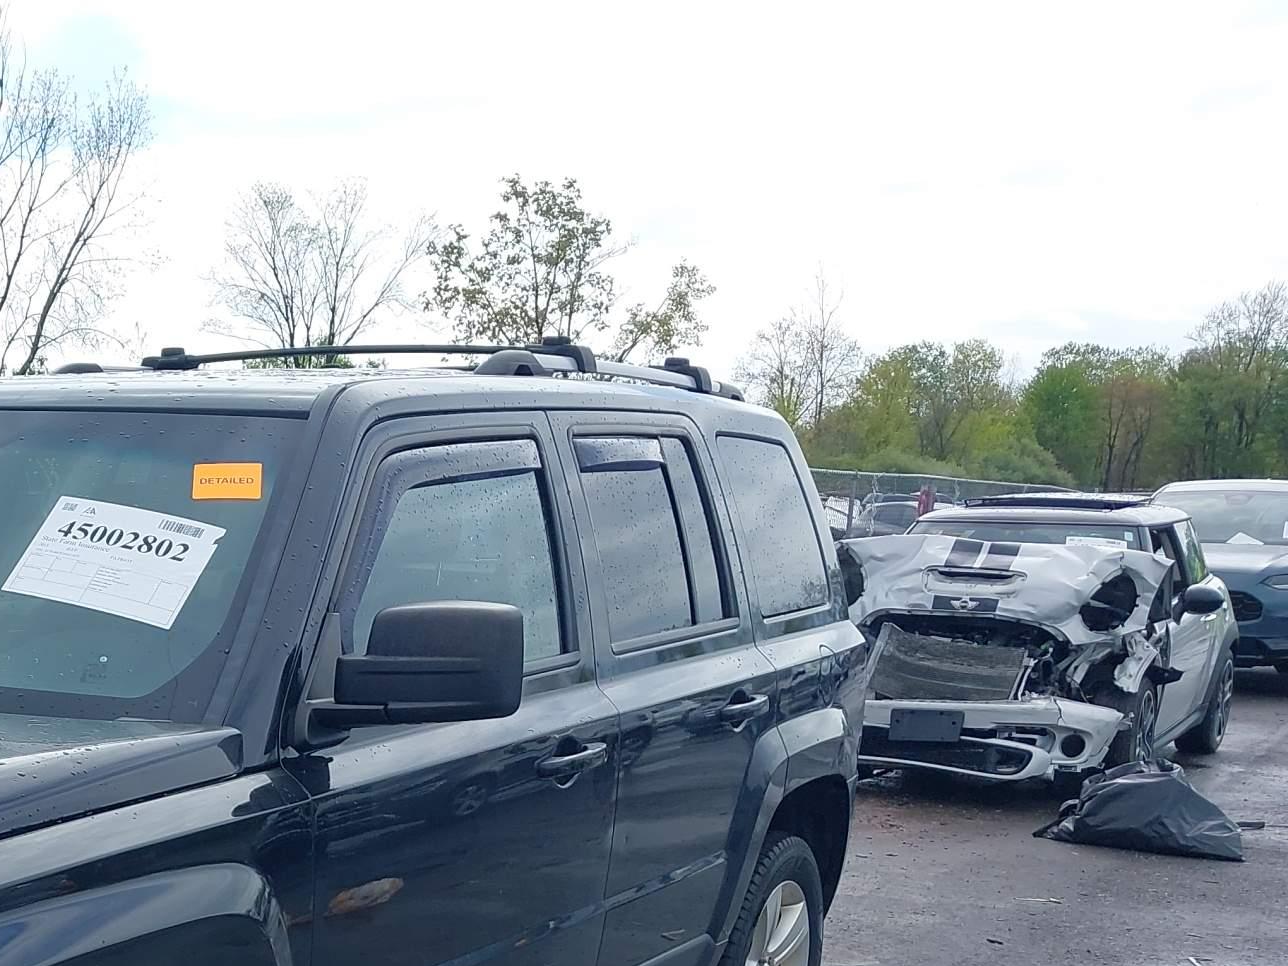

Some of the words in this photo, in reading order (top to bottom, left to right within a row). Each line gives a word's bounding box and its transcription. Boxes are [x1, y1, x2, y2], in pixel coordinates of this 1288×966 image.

[199, 477, 254, 485] DETAILED
[41, 535, 59, 543] State
[59, 538, 77, 546] Farm
[78, 541, 111, 553] Insurance
[58, 520, 190, 562] 45002802
